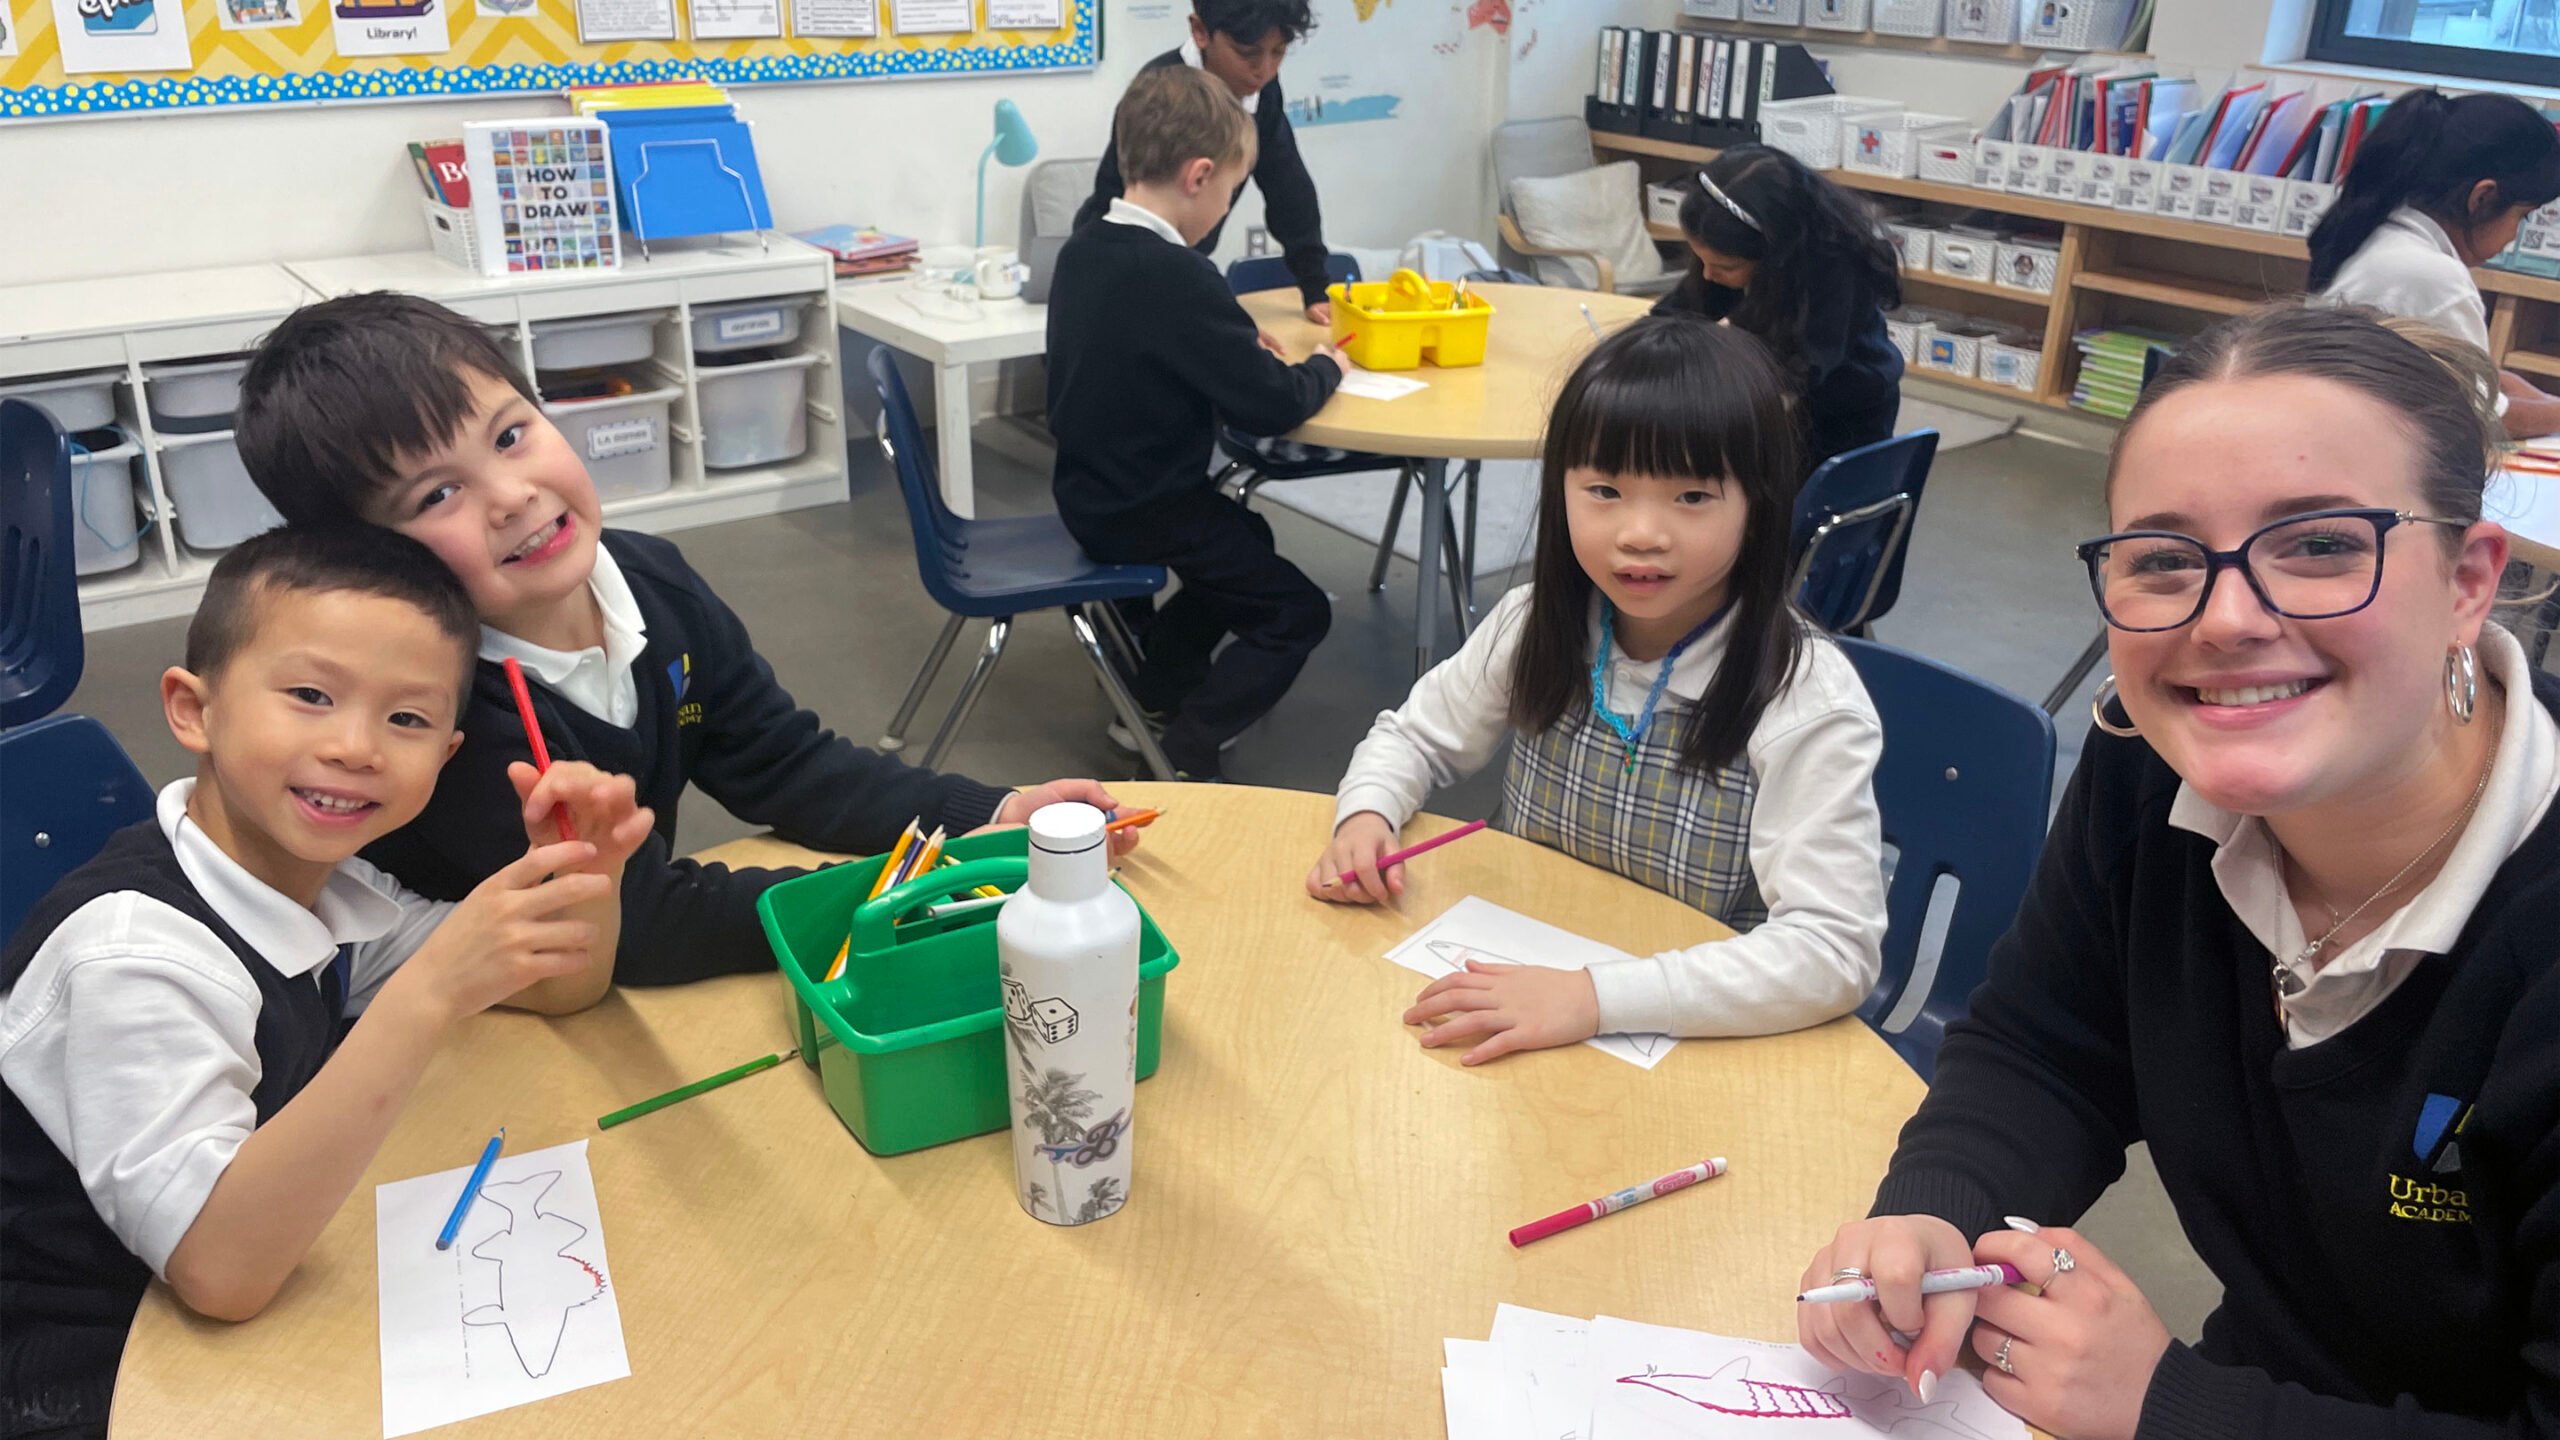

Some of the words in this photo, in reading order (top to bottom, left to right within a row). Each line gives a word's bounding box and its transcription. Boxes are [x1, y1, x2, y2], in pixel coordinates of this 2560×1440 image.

[366, 26, 418, 40] Library!
[526, 168, 577, 183] HOW
[540, 186, 568, 200] TO
[525, 203, 588, 219] DRAW
[2388, 1173, 2469, 1207] Urba
[2388, 1201, 2472, 1224] ACADEM
